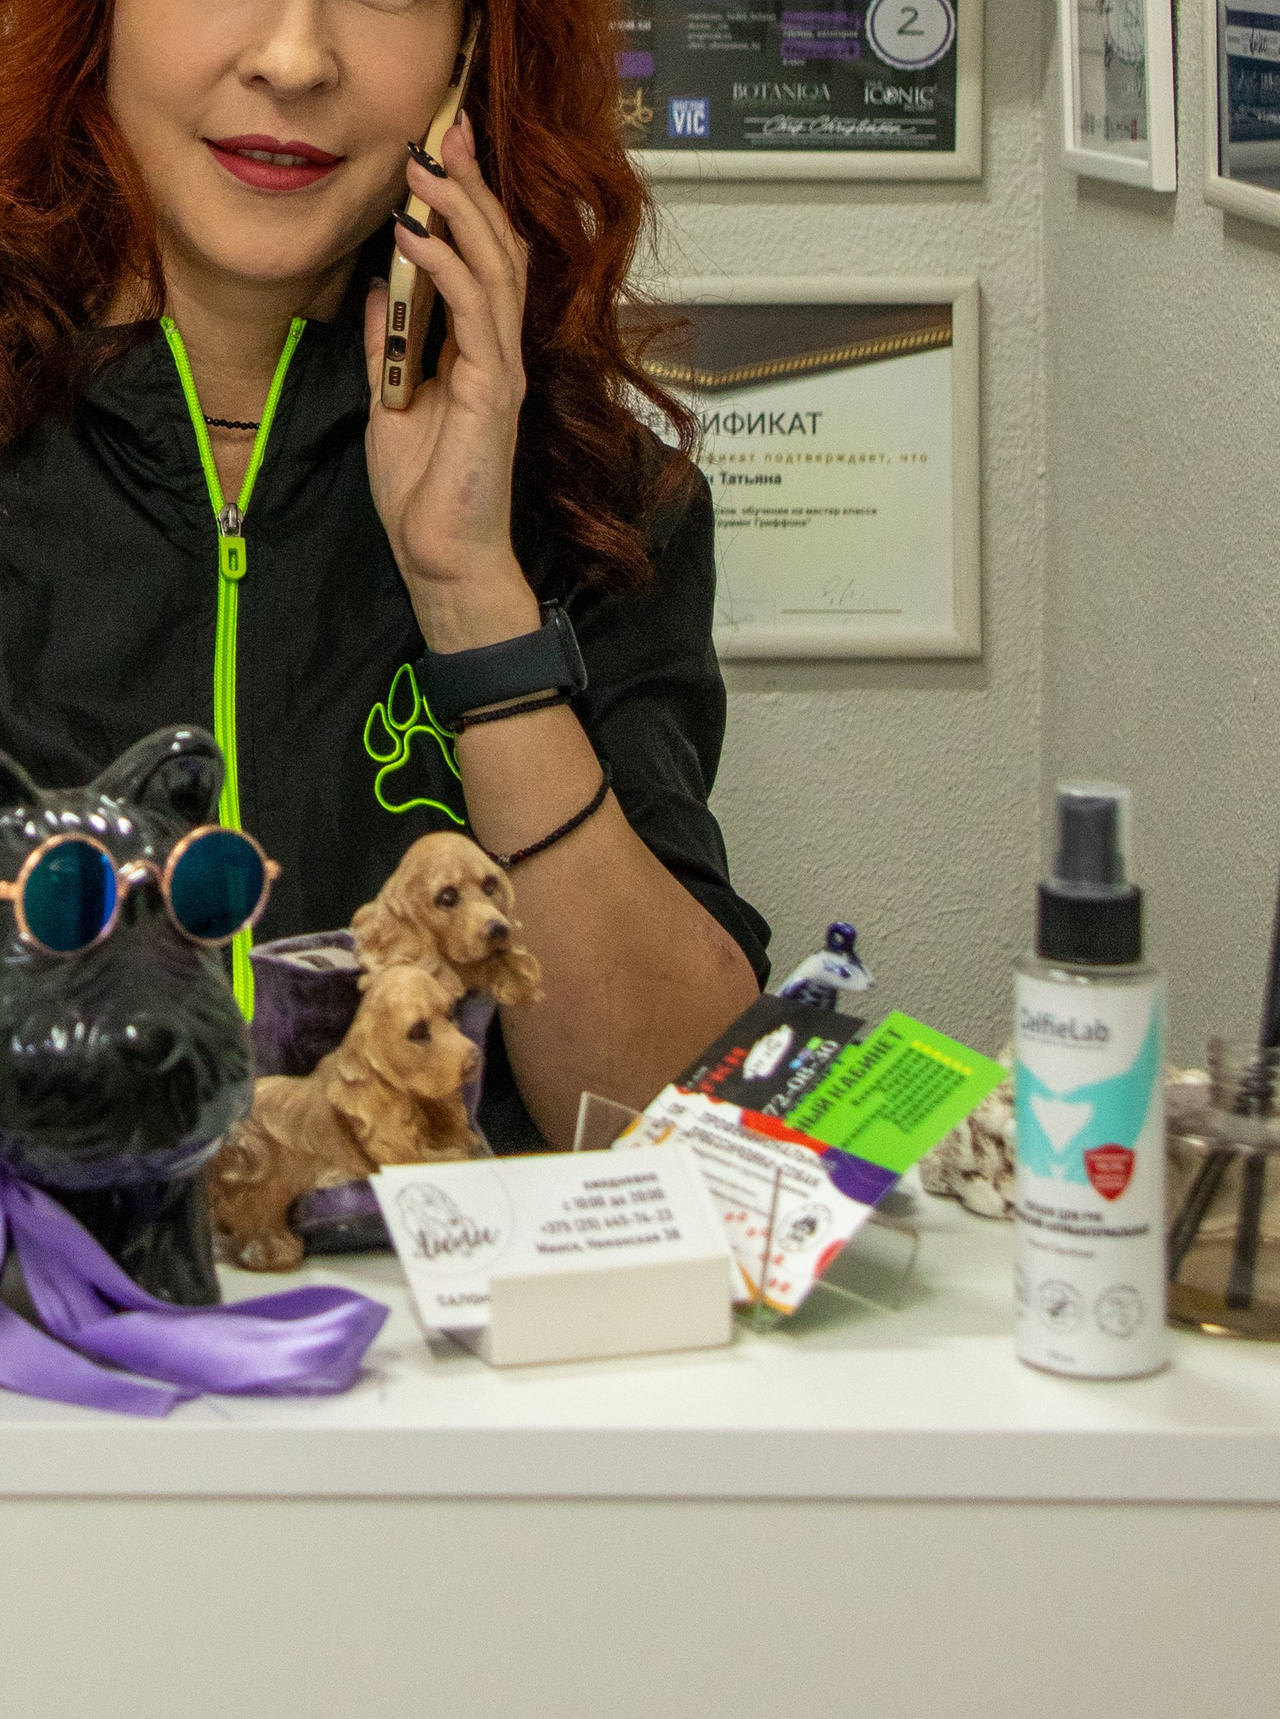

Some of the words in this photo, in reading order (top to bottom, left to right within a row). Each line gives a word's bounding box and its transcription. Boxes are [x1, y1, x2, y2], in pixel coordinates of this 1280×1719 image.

[896, 6, 925, 37] 2
[672, 111, 707, 136] VIC
[702, 411, 824, 436] ИФИКАТ
[900, 453, 928, 464] что
[720, 471, 782, 485] Татьяна
[832, 1027, 905, 1097] КАБИНЕТ
